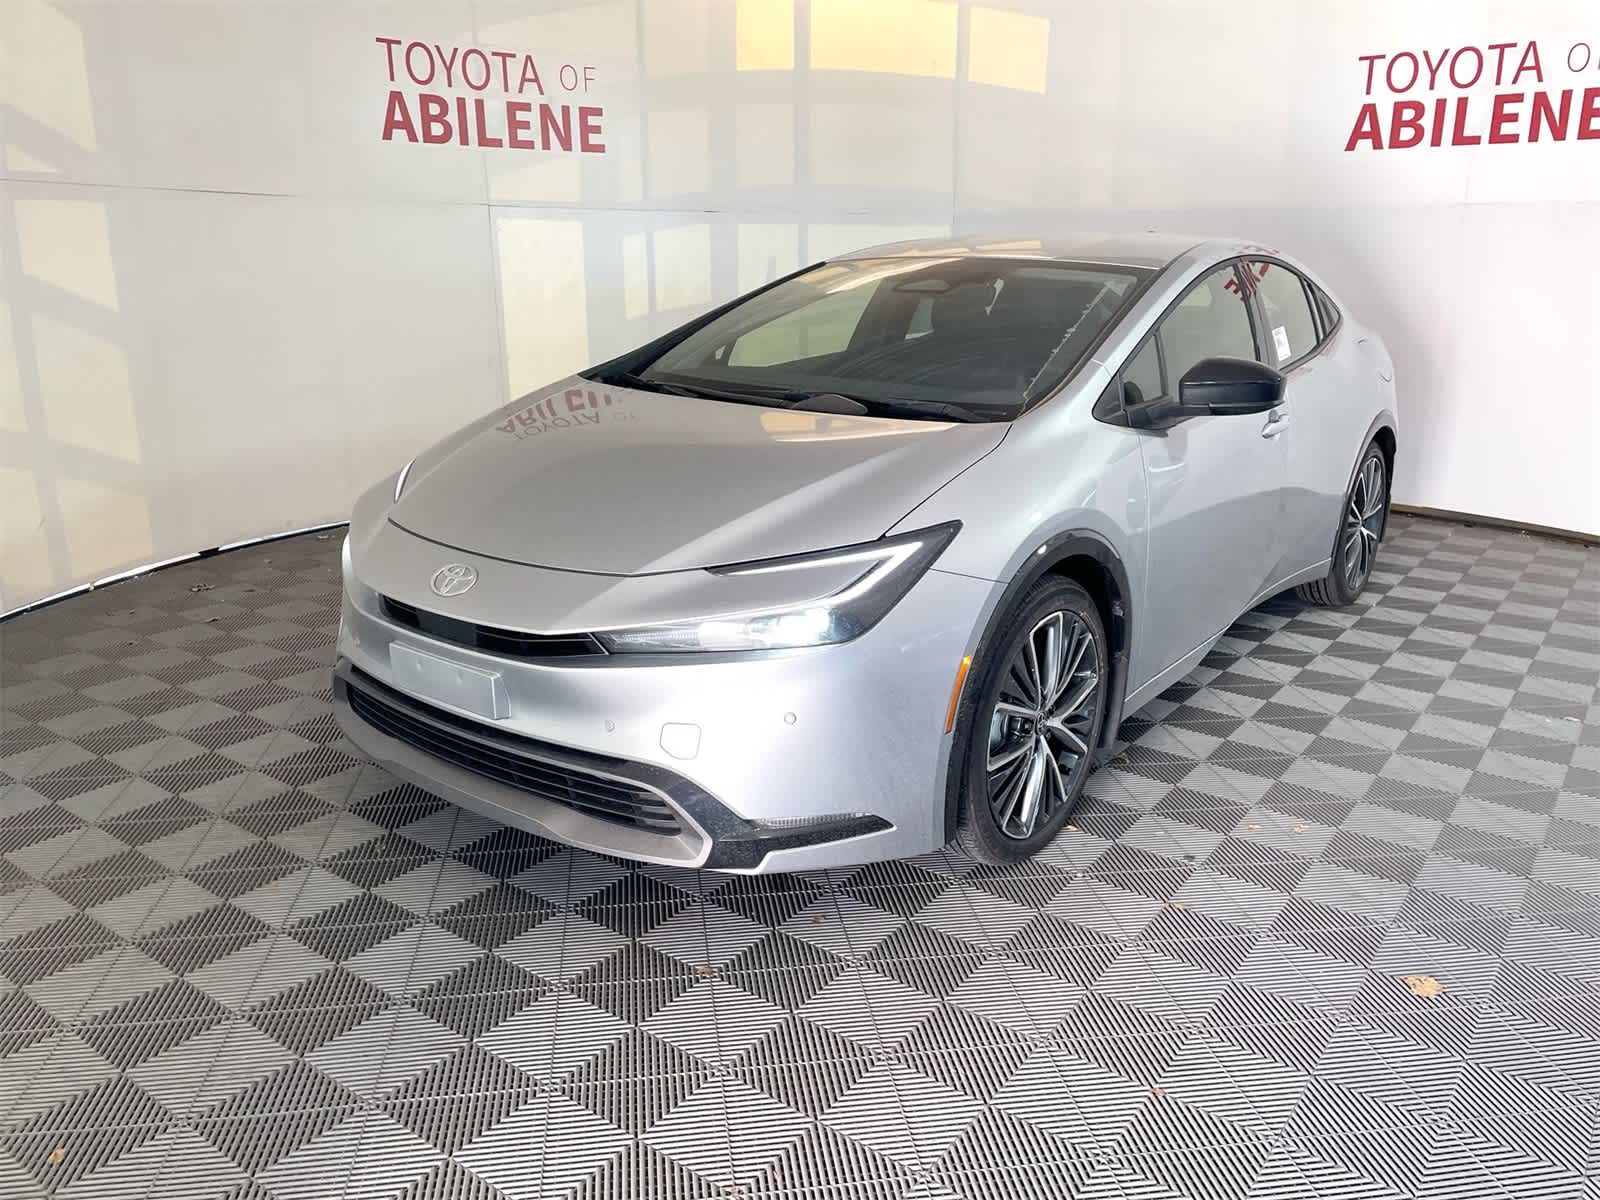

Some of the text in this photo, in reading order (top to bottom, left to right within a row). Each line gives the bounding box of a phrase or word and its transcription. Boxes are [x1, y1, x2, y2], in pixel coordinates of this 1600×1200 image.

[376, 37, 596, 96] TOYOTA OF
[1358, 40, 1600, 95] TOYOTA O
[382, 90, 606, 153] ABILENE
[1344, 87, 1600, 152] ABILENE
